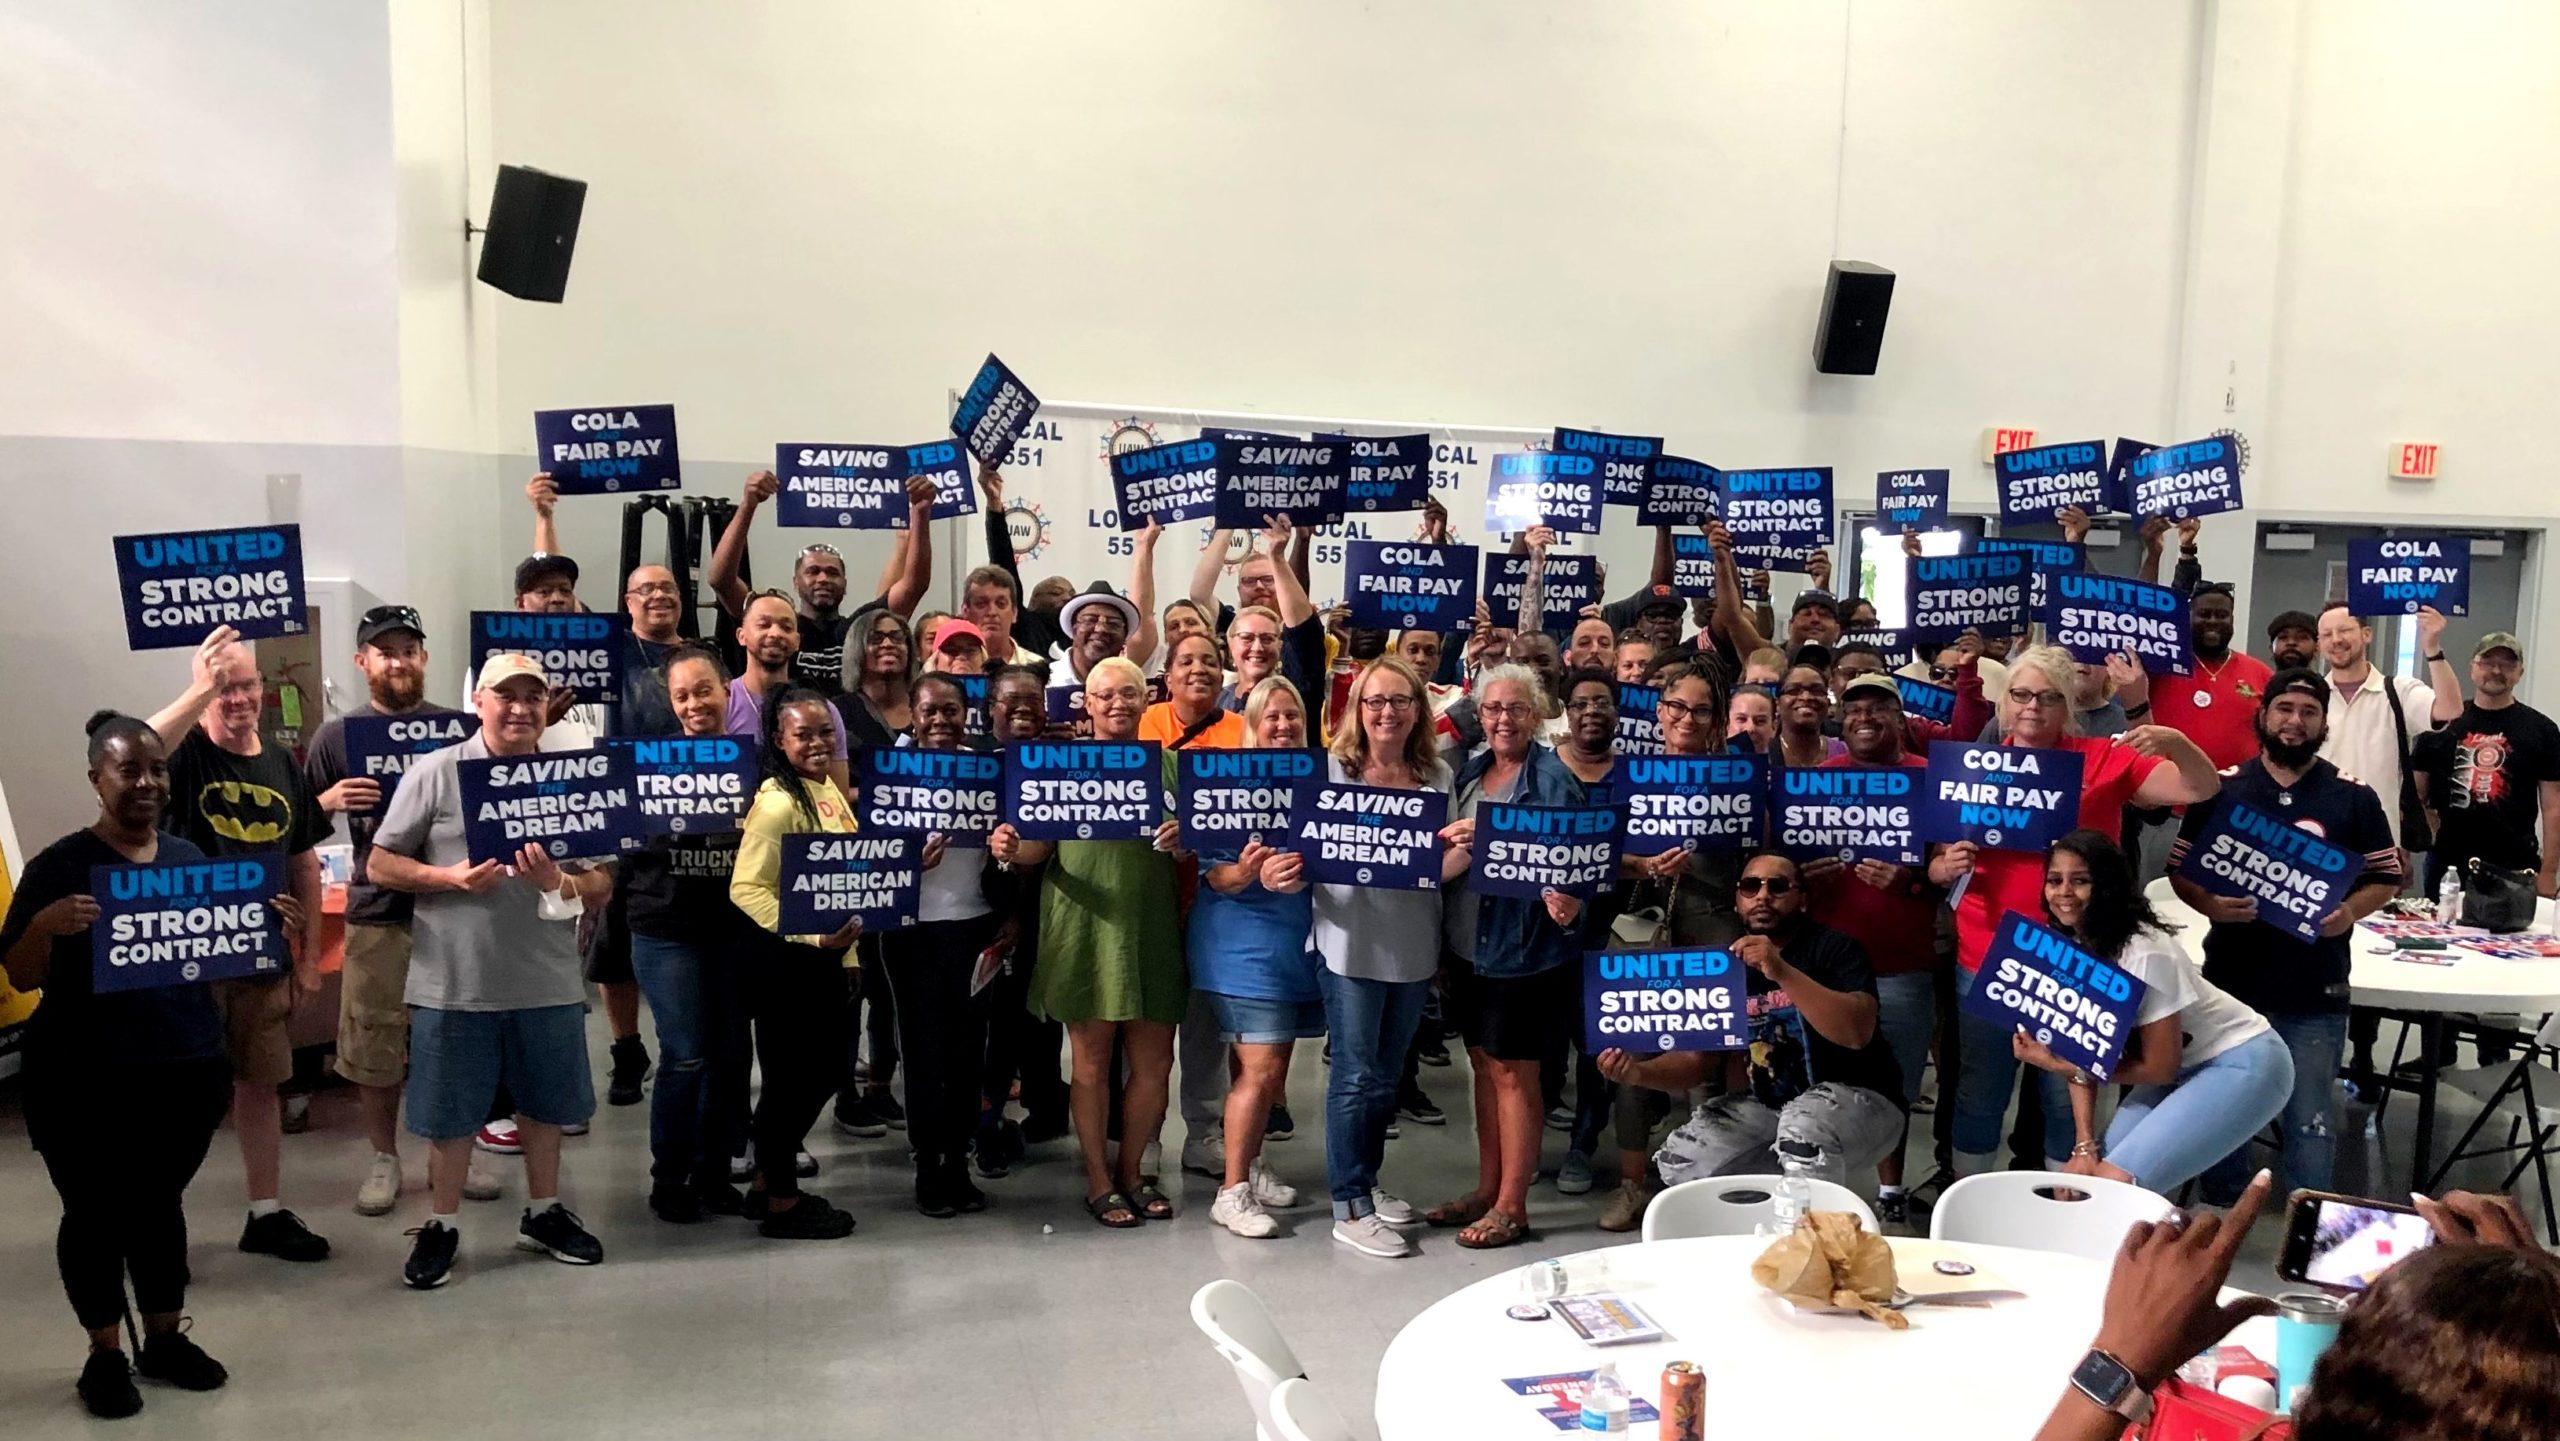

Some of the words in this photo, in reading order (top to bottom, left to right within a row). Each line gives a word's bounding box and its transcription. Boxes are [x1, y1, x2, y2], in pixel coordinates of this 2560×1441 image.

[953, 364, 999, 434] UNITED
[571, 411, 639, 430] COLA
[969, 380, 1016, 450] STRONG
[979, 390, 1027, 464] CONTRACT
[1018, 420, 1064, 441] CAL
[553, 442, 608, 462] FAIR
[616, 438, 662, 457] PAY
[1238, 446, 1333, 466] SAVING
[1562, 432, 1652, 457] UNITED
[579, 458, 640, 479] NOW
[799, 449, 889, 468] SAVING
[1120, 441, 1216, 476] UNITED
[1502, 455, 1595, 476] UNITED
[2005, 445, 2097, 473] UNITED
[2132, 441, 2225, 477] UNITED
[2401, 444, 2438, 475] EXIT
[832, 466, 857, 477] THE
[1274, 466, 1297, 476] THE
[1377, 465, 1417, 481] PAY
[1728, 472, 1822, 492] UNITED
[1891, 474, 1925, 488] COLA
[787, 476, 900, 495] AMERICAN
[1125, 468, 1216, 501] STRONG
[1226, 475, 1340, 492] AMERICAN
[1347, 483, 1396, 497] NOW
[1498, 482, 1592, 503] STRONG
[2009, 469, 2099, 497] STRONG
[2136, 466, 2228, 500] STRONG
[806, 492, 883, 509] DREAM
[1126, 488, 1216, 516] CONTRAC
[1244, 492, 1320, 508] DREAM
[1728, 499, 1822, 517] STRONG
[1882, 496, 1908, 510] FAIR
[1911, 494, 1938, 508] PAY
[2009, 488, 2102, 512] CONTRACT
[2136, 484, 2231, 515] CONTRACT
[1726, 517, 1824, 534] CONTRACT
[1892, 509, 1920, 523] NOW
[134, 532, 286, 568] UNITED
[1108, 536, 1134, 556] 55
[1316, 546, 1347, 564] 55
[1380, 548, 1445, 566] COLA
[2380, 541, 2442, 558] COLA
[1400, 567, 1424, 576] AND
[1503, 559, 1580, 576] SAING
[1917, 555, 2022, 581] UNITED
[2401, 557, 2423, 566] AND
[1359, 575, 1412, 594] FAIR
[1418, 578, 1463, 596] PAY
[2361, 568, 2413, 583] FAIR
[2418, 567, 2459, 583] PAY
[141, 570, 289, 605] STRONG
[1492, 583, 1587, 598] AMICAN
[1917, 585, 2020, 610] STRONG
[2060, 575, 2177, 612] UNITED
[2383, 583, 2438, 600] NOW
[142, 597, 293, 628] CONTRACT
[1381, 596, 1439, 613] NOW
[1507, 597, 1571, 612] DAM
[1915, 605, 2021, 627] CONTRACT
[487, 617, 609, 640] UNITED
[2059, 607, 2179, 642] STRONG
[2058, 629, 2181, 660] CONTRACT
[388, 719, 465, 741] COLA
[609, 739, 739, 765] NITED
[1020, 745, 1147, 770] UNITED
[1963, 749, 2041, 775] COLA
[488, 755, 609, 787] SAVING
[657, 764, 682, 774] FOR
[684, 765, 694, 773] A
[875, 751, 999, 779] UNITED
[1066, 771, 1090, 780] FOR
[1192, 753, 1314, 778] UNITED
[1629, 760, 1754, 784] UNITED
[537, 782, 566, 795] THE
[637, 773, 741, 795] TRONG
[919, 778, 945, 788] FOR
[1238, 778, 1262, 788] FOR
[1674, 785, 1698, 794] FOR
[1785, 772, 1910, 796] UNITED
[1983, 772, 2014, 784] AND
[873, 785, 997, 811] STRONG
[1020, 780, 1147, 802] STRONG
[1193, 788, 1293, 811] STRON
[1829, 796, 1852, 806] FOR
[1940, 780, 1998, 806] FAIR
[2005, 786, 2063, 811] PAY
[478, 788, 628, 822] AMERICAN
[640, 796, 744, 816] NTRACT
[1018, 803, 1150, 822] CONTRACT
[1316, 790, 1425, 818] SAVING
[1629, 794, 1752, 816] STRONG
[505, 811, 606, 839] DREAM
[870, 808, 998, 831] CONTRACT
[1191, 812, 1291, 831] CONTRA
[1356, 814, 1383, 826] THE
[1491, 807, 1616, 834] UNITED
[1627, 816, 1753, 836] CONTRACT
[1785, 806, 1910, 827] STRONG
[1960, 804, 2031, 830] NOW
[1300, 821, 1433, 849] AMERICAN
[1536, 835, 1561, 844] FOR
[1782, 829, 1912, 847] CONTRACT
[2229, 805, 2347, 873] UNITED
[806, 838, 904, 861] SAVING
[1321, 842, 1410, 866] DREAM
[1487, 840, 1611, 866] STRONG
[845, 859, 869, 871] THE
[1483, 861, 1610, 885] CONTRACT
[2211, 834, 2330, 901] STRONG
[110, 861, 265, 901] UNITED
[792, 869, 912, 892] AMERICAN
[2200, 853, 2322, 919] CONTRACT
[814, 889, 894, 911] DREAM
[111, 902, 265, 941] STRONG
[109, 931, 268, 967] CONTRACT
[1600, 951, 1729, 980] UNITED
[2013, 921, 2131, 1002] UNITED
[1647, 979, 1671, 989] FOR
[1673, 980, 1682, 989] A
[2051, 968, 2076, 987] FOR
[2073, 981, 2084, 992] A
[1600, 987, 1730, 1014] STRONG
[1997, 956, 2118, 1036] STRONG
[1598, 1012, 1734, 1035] CONTRACT
[1986, 981, 2112, 1058] CONTRACT
